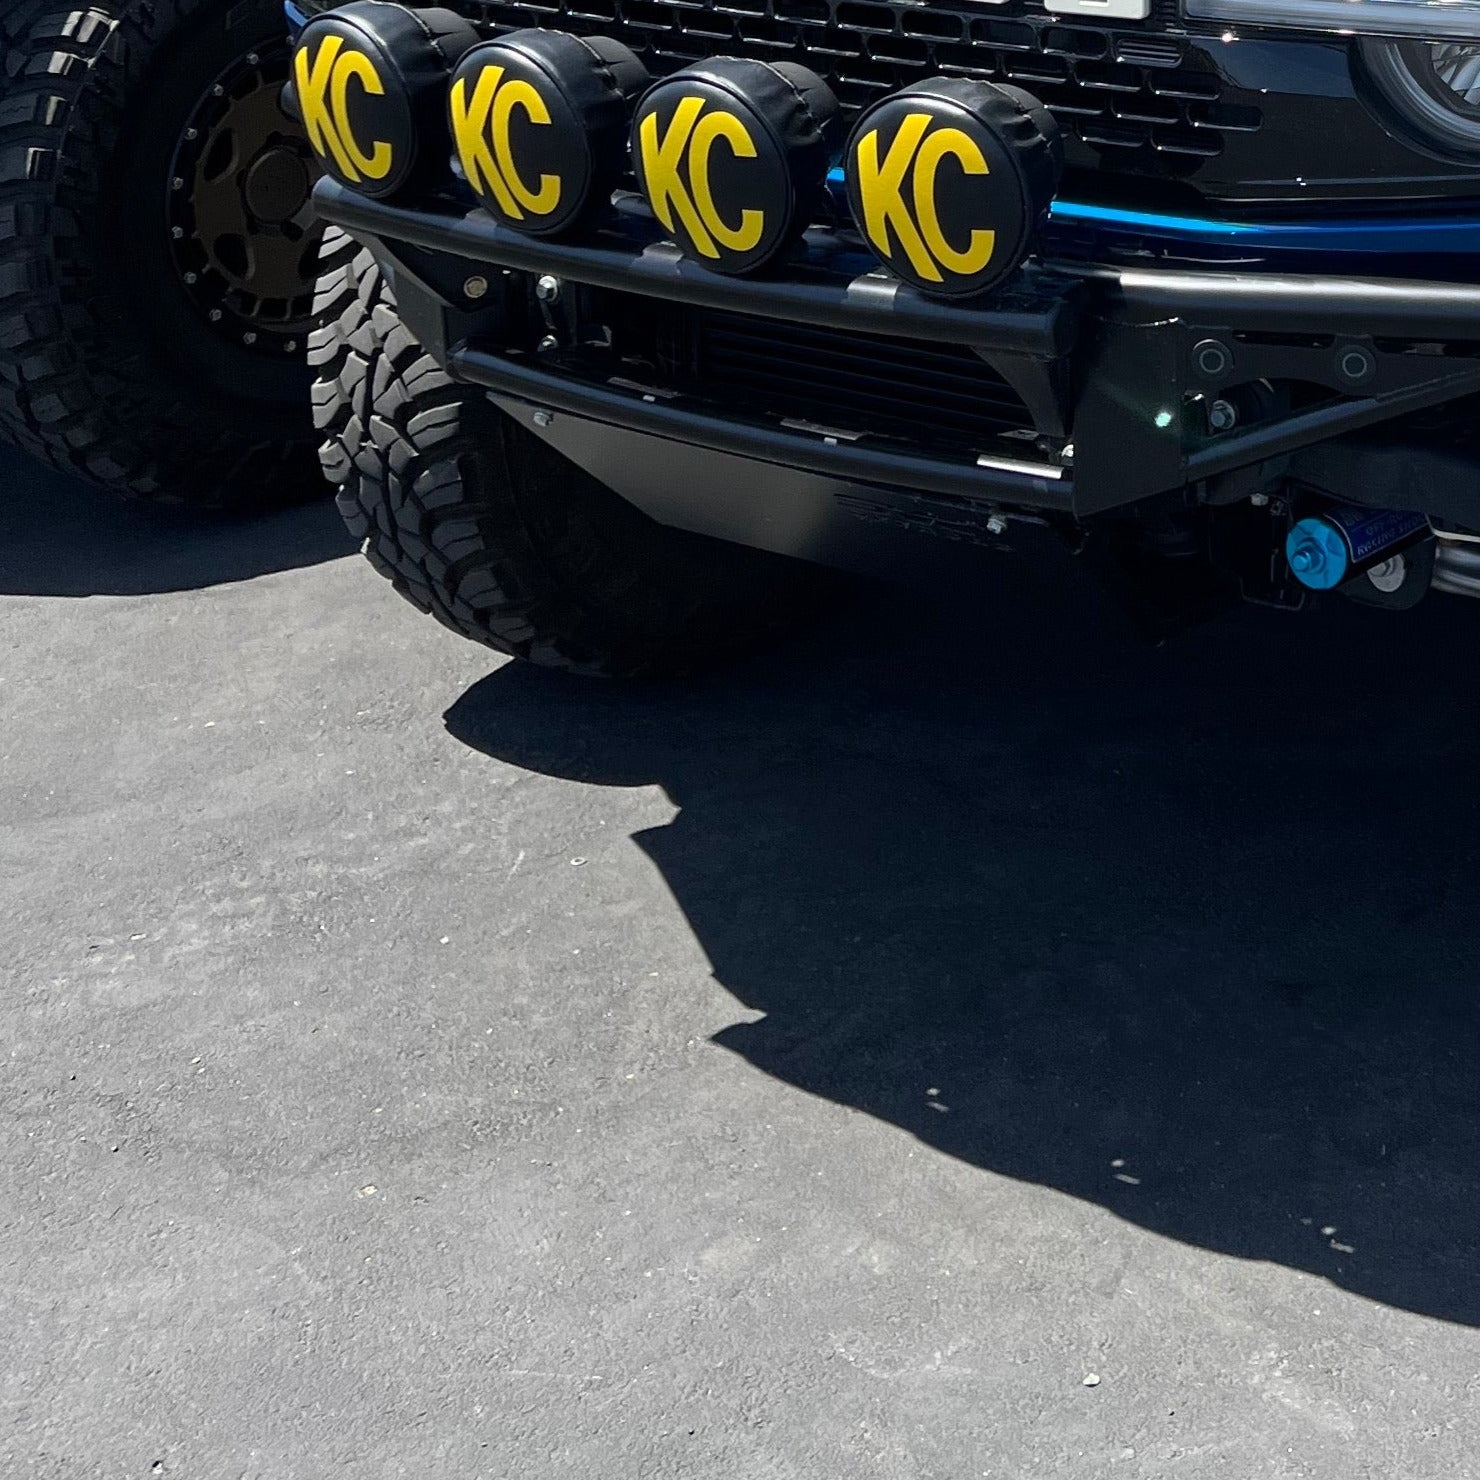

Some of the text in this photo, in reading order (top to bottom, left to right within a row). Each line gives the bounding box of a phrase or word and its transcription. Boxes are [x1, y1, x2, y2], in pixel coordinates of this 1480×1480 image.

[294, 35, 392, 183] KC
[450, 65, 561, 219] KC
[640, 97, 764, 259] KC
[857, 113, 996, 282] KC
